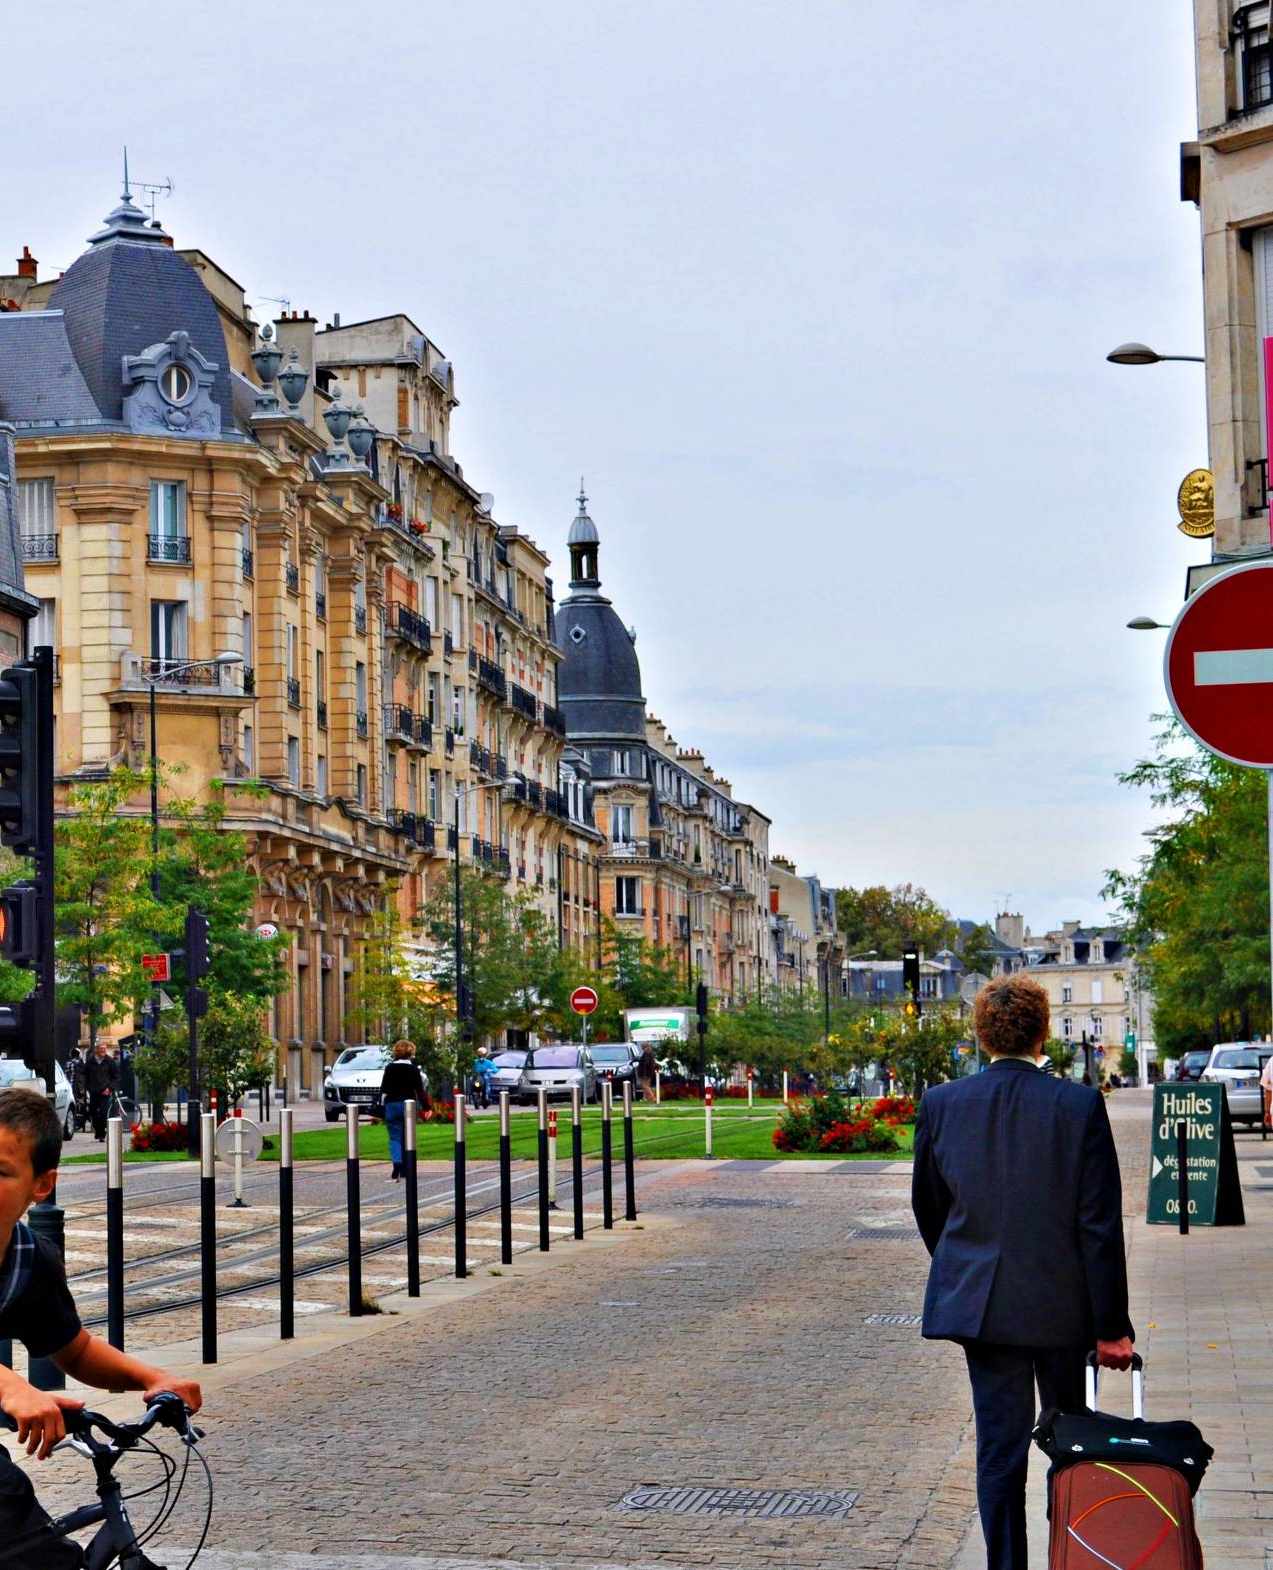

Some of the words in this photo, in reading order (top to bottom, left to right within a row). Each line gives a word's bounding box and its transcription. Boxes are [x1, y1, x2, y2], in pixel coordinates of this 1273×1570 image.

[1162, 1092, 1213, 1115] Huiles
[1164, 1155, 1217, 1170] dégstation
[1186, 1170, 1208, 1181] ente
[1166, 1199, 1198, 1214] O&O.
